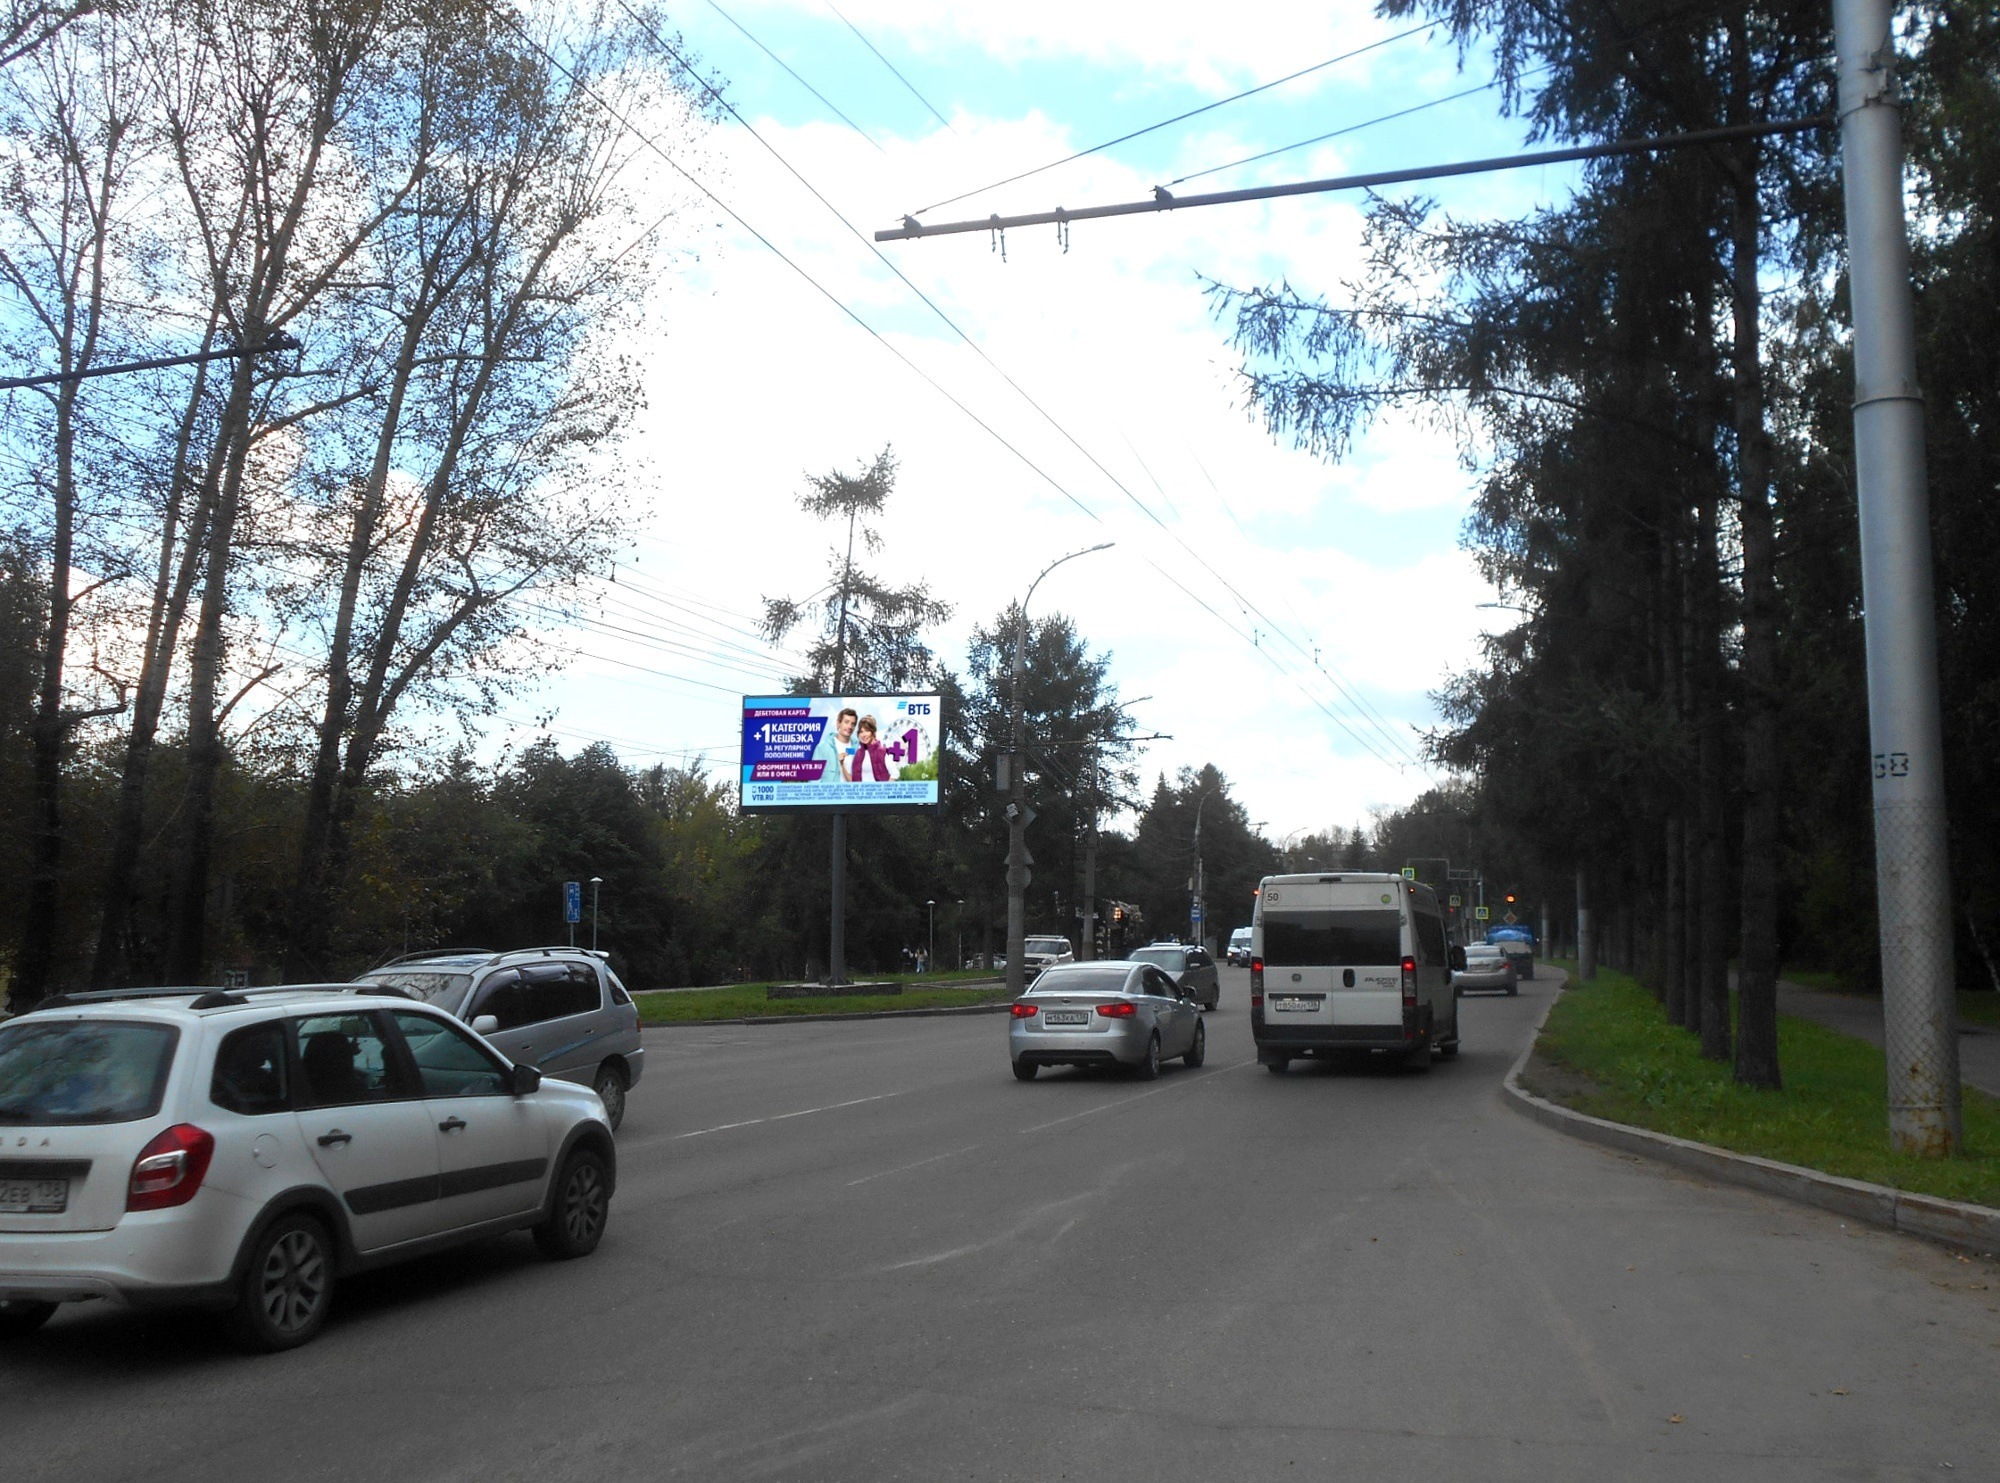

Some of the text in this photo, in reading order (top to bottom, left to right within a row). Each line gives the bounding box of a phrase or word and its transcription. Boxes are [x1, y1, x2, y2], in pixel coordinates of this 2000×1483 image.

[908, 704, 931, 715] ВТБ
[772, 723, 821, 732] КАТЕГОРИЯ
[753, 723, 771, 743] +1
[771, 734, 814, 743] КЕШБЭКА
[1267, 893, 1279, 901] 50
